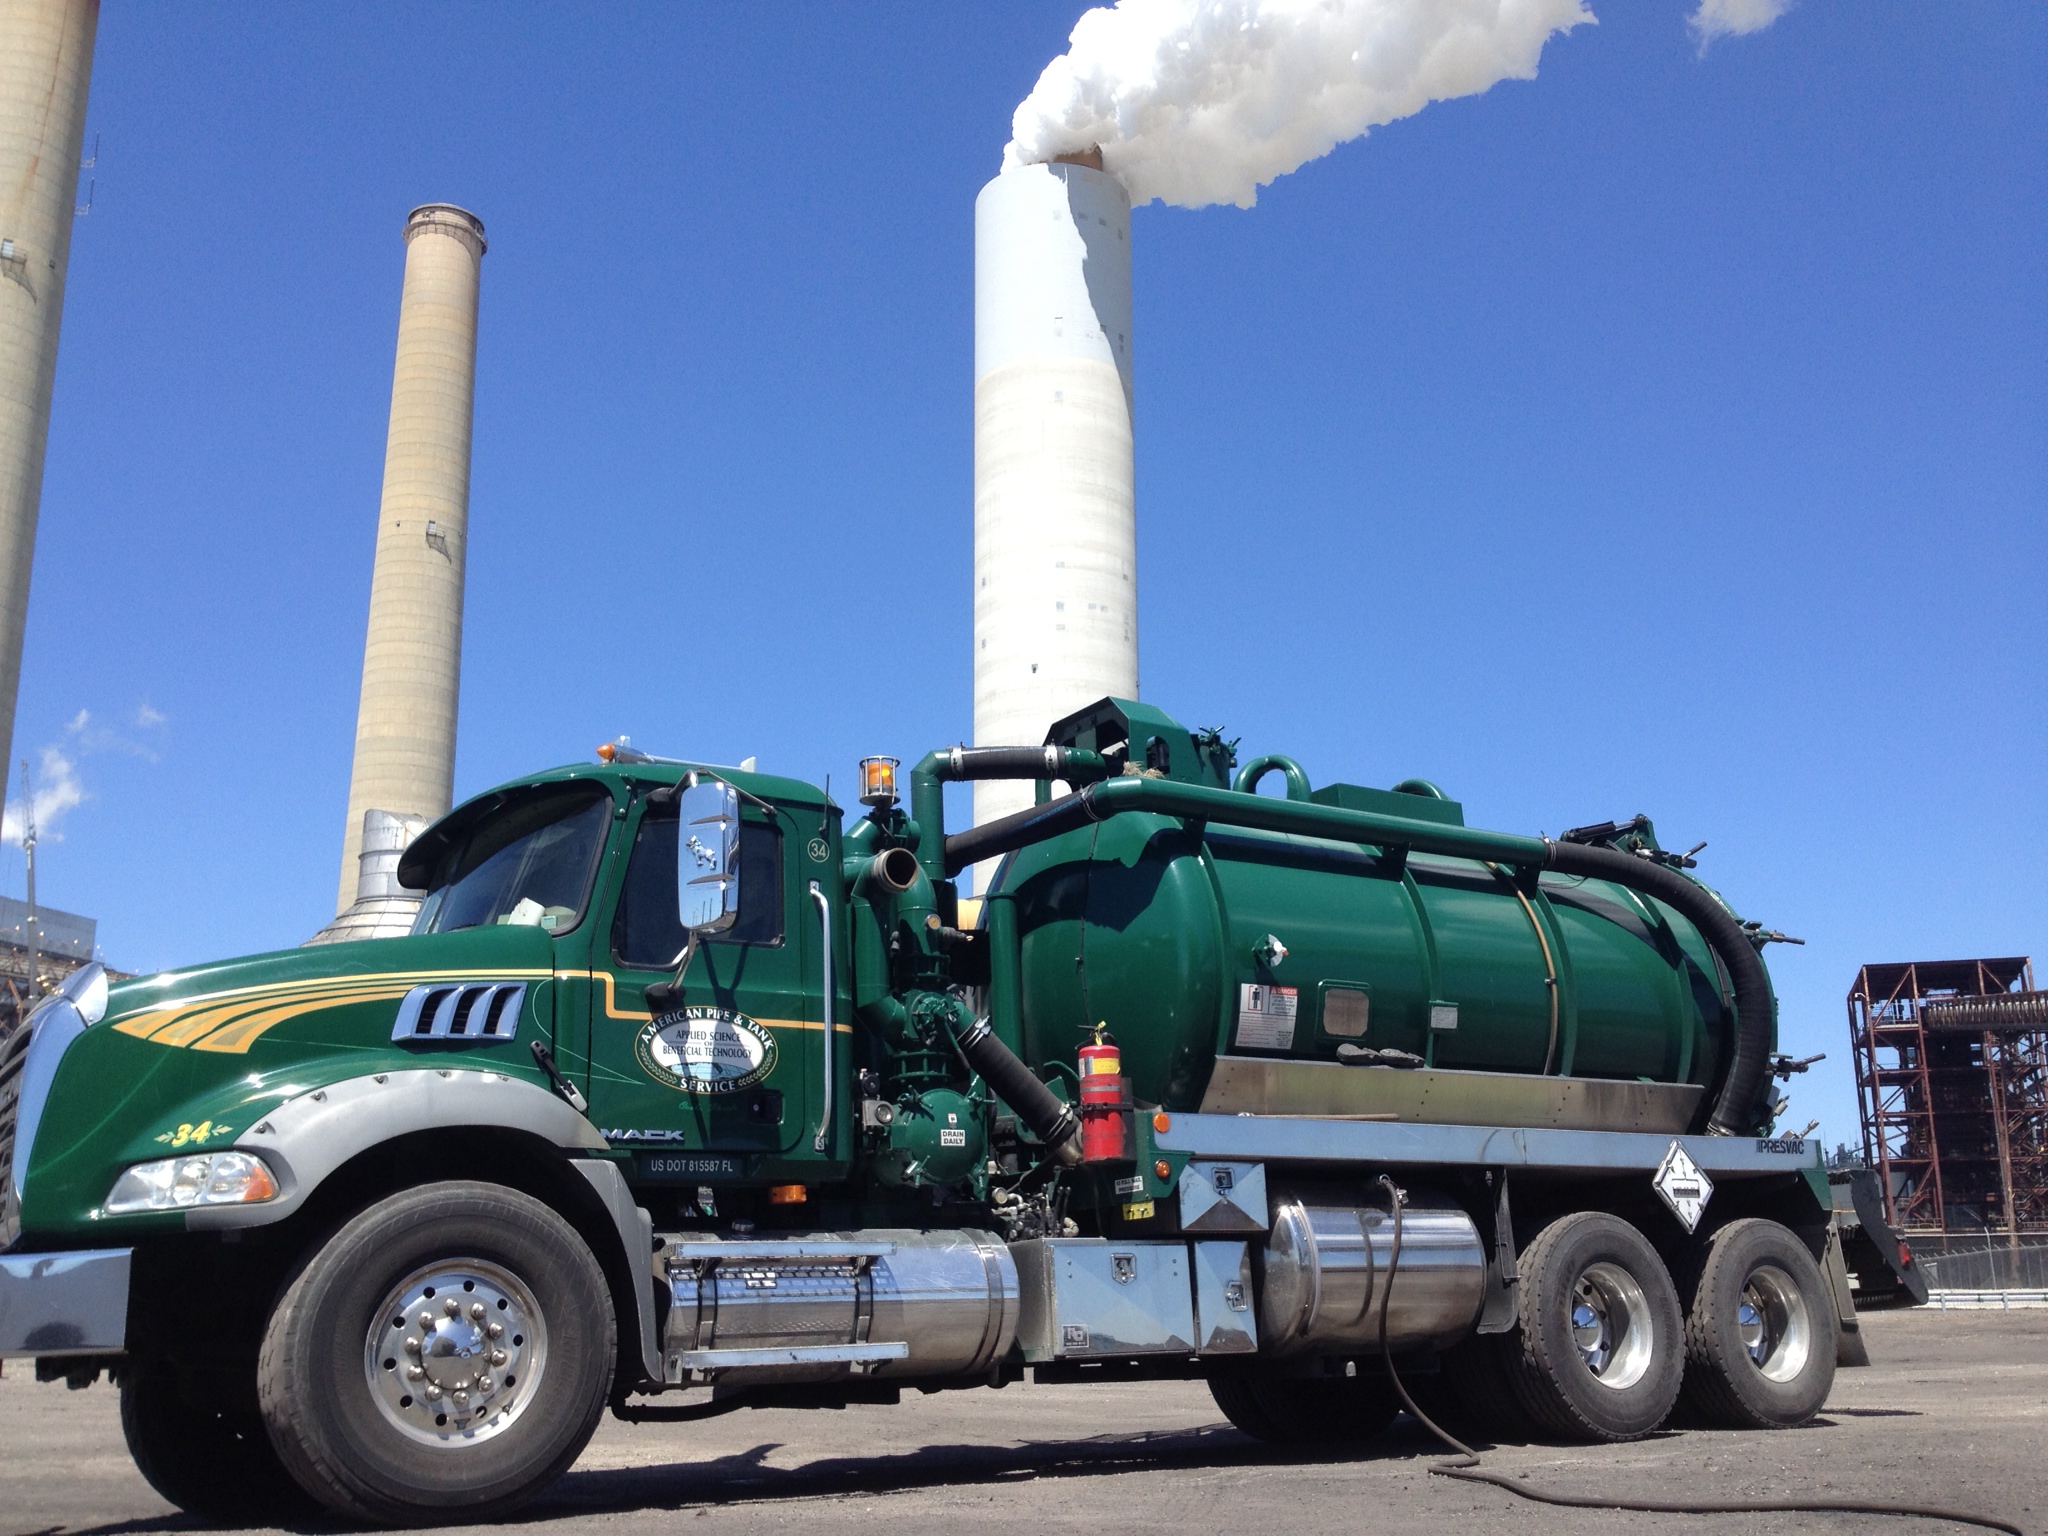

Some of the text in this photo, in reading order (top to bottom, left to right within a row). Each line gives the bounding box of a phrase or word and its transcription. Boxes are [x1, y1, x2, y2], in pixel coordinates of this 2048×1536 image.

[811, 842, 827, 858] 34
[641, 1008, 774, 1050] AMERICAN PIPE & TANK
[676, 1030, 741, 1042] APPLIED SCIENCE
[662, 1045, 752, 1059] BENEFICIAL TECHNOLOGY
[680, 1078, 736, 1092] SERVICE
[171, 1120, 212, 1148] 34
[600, 1128, 684, 1140] MACK
[1760, 1139, 1805, 1155] PRESVAC
[651, 1160, 733, 1172] US DOT 815587 FL
